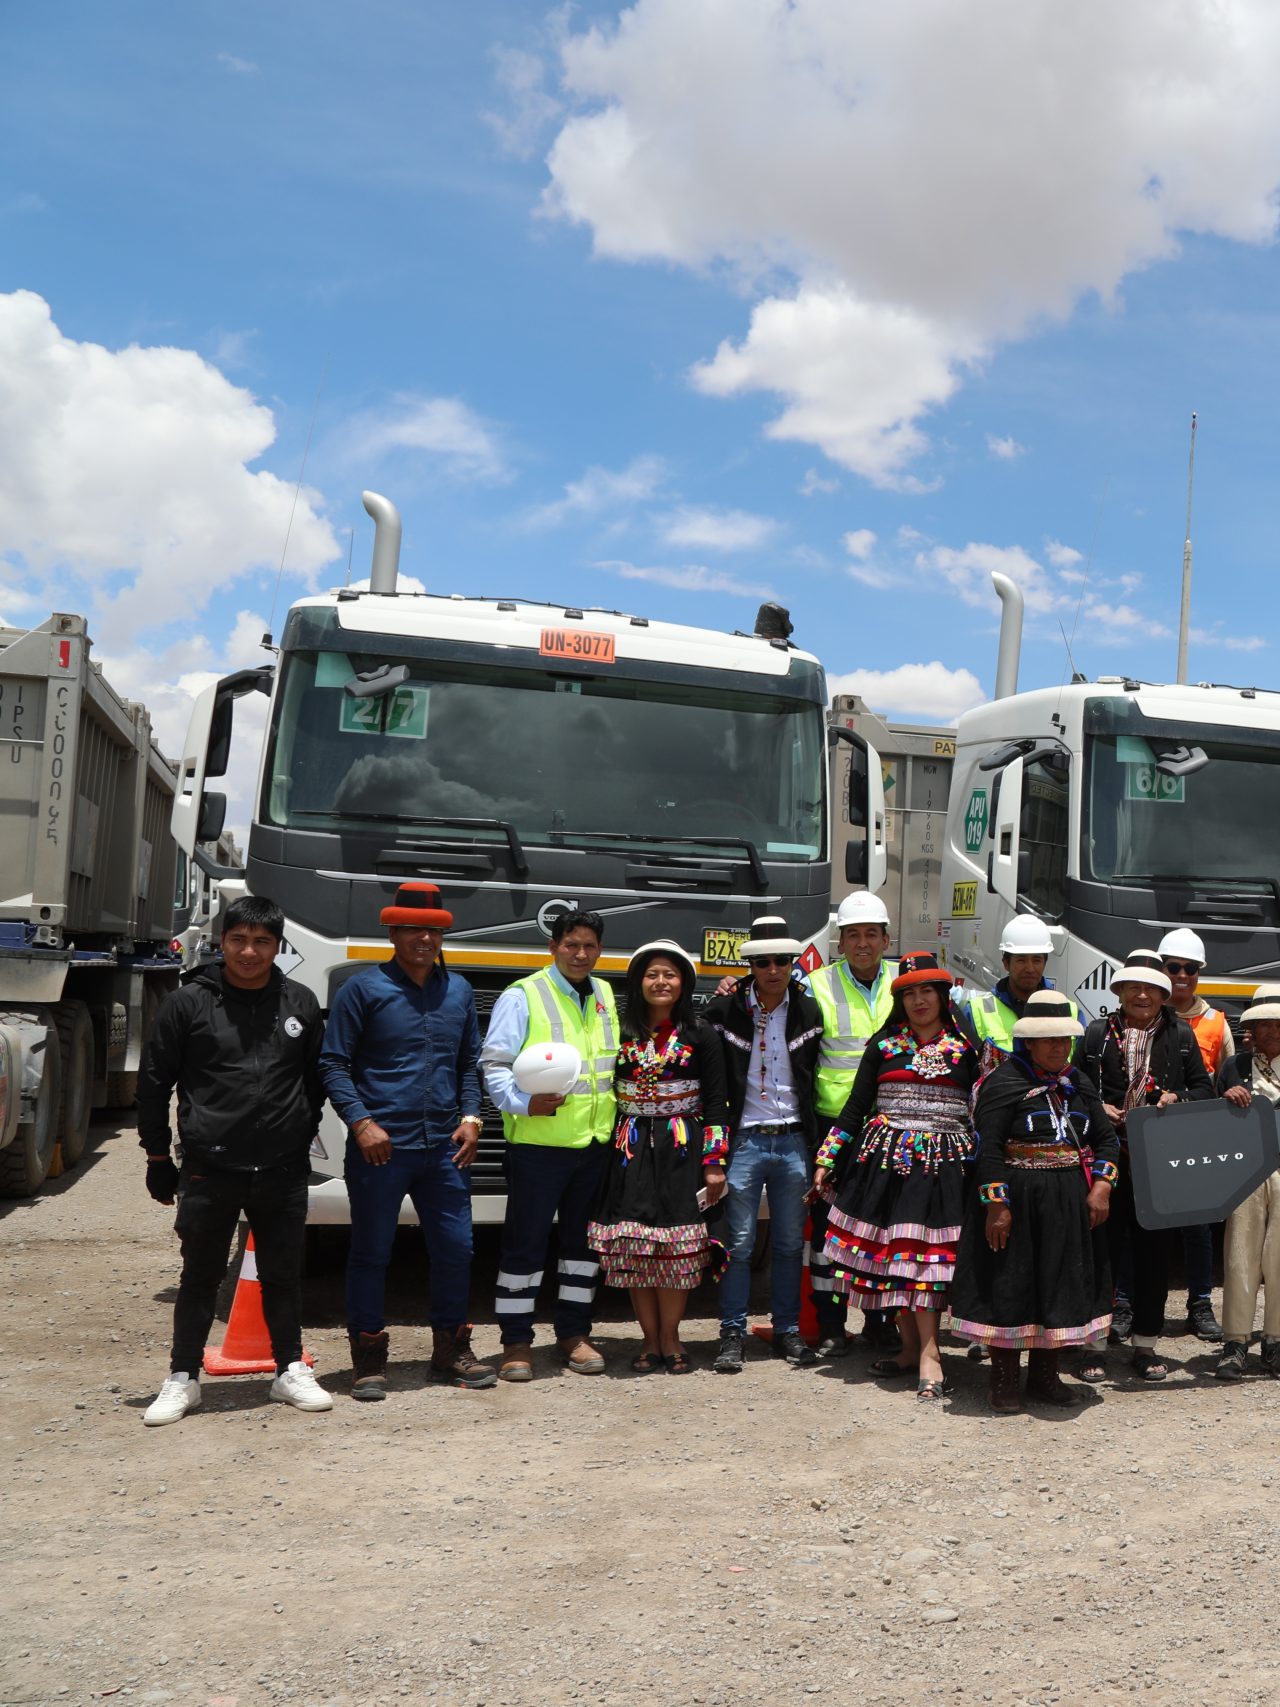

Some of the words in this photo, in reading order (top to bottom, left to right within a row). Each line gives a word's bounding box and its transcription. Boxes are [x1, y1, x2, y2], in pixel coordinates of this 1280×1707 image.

[544, 631, 611, 657] UN-3077
[923, 764, 937, 775] MGW
[968, 797, 986, 816] APU
[967, 821, 982, 845] 019
[921, 844, 934, 854] KGS
[918, 914, 931, 924] LBS
[708, 940, 741, 960] BZX-
[806, 952, 814, 970] 1
[1099, 1005, 1108, 1018] 9
[1168, 1152, 1244, 1168] VOLVO
